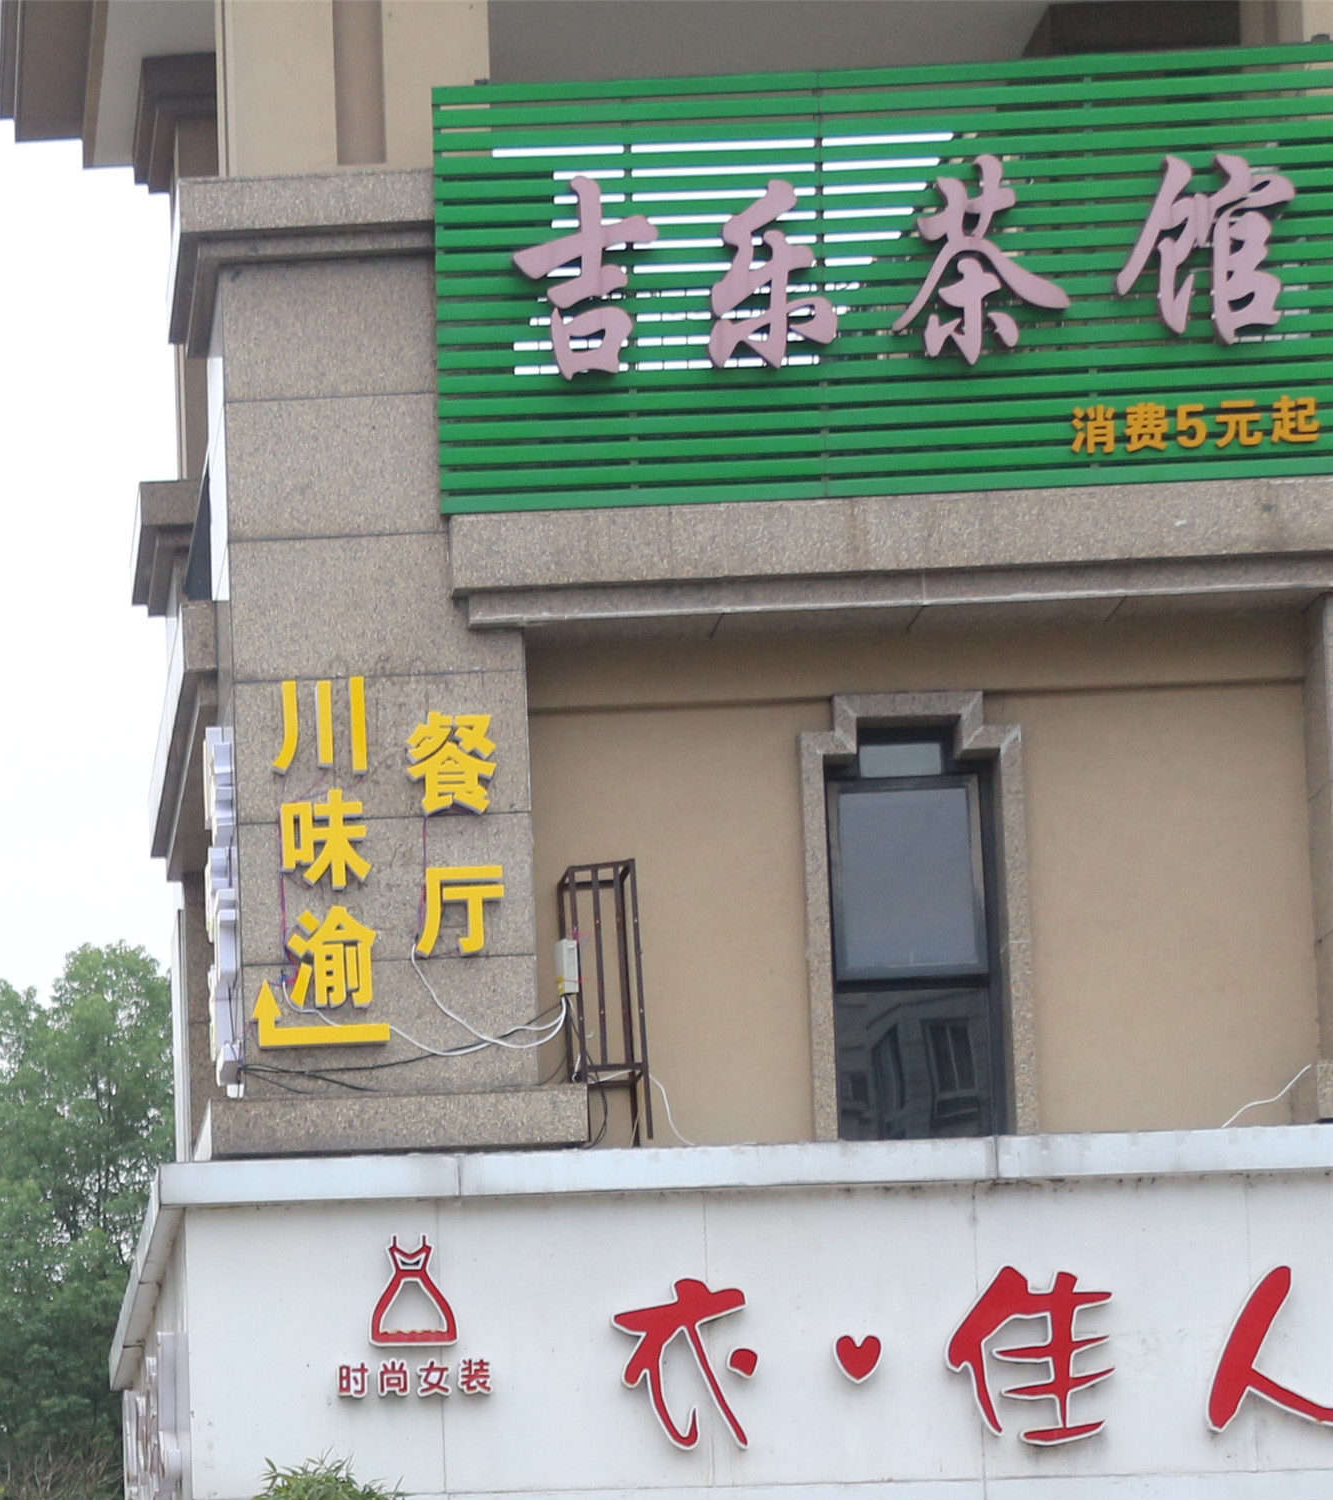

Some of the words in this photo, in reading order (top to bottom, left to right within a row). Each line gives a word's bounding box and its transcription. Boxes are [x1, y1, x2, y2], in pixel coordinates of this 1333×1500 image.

[513, 154, 1295, 380] 吉乐茶馆
[1071, 395, 1320, 454] 消费5元起
[272, 676, 377, 1008] 川味渝
[406, 711, 504, 957] 餐厅
[338, 1358, 493, 1398] 时尚女装
